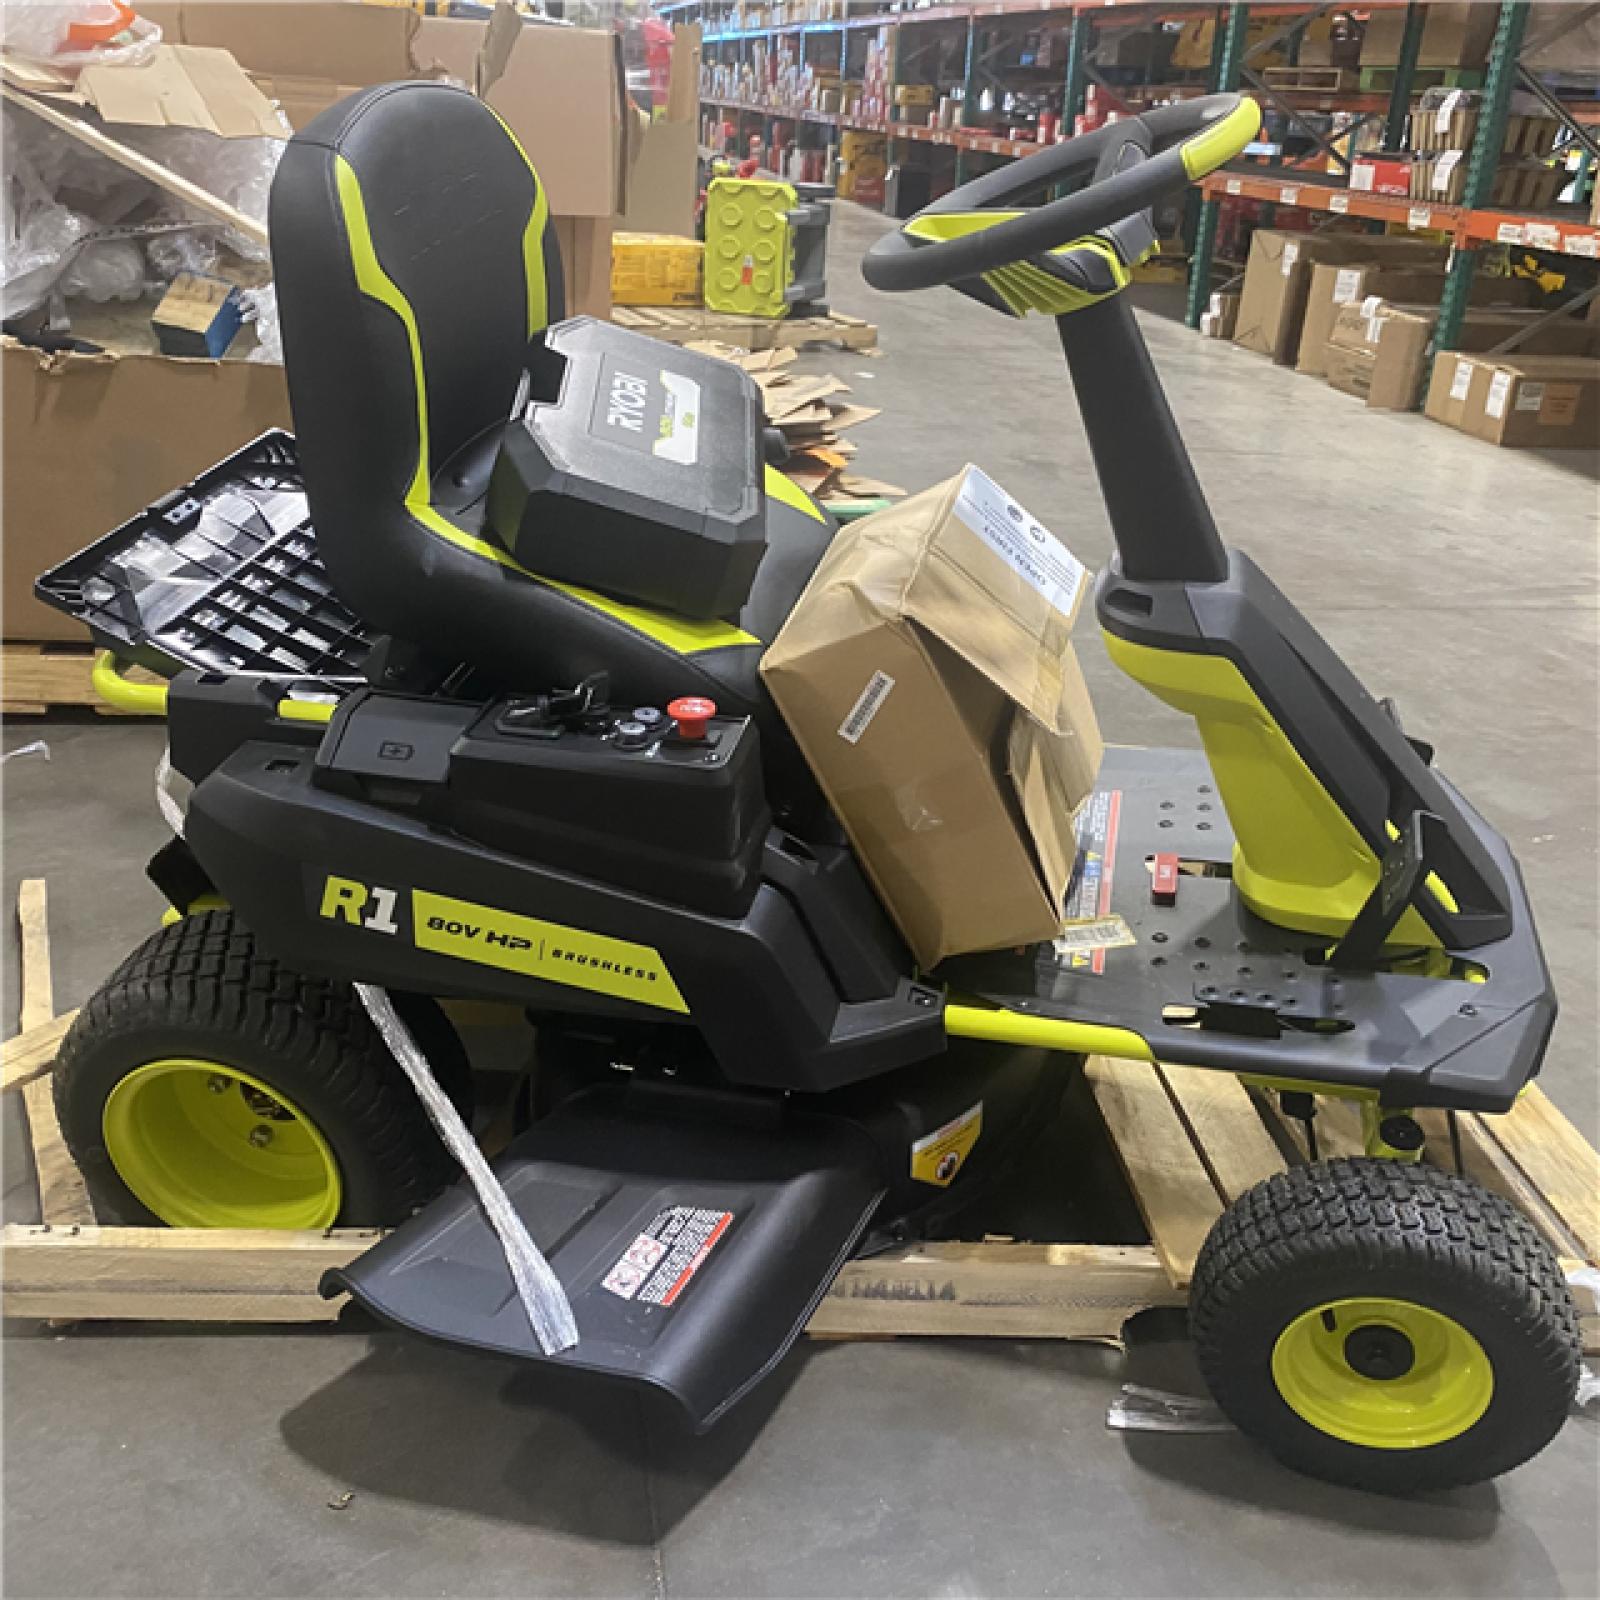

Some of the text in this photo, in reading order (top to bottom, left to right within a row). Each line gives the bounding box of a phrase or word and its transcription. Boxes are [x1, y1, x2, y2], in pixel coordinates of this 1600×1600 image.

[607, 371, 647, 432] RYOBI
[320, 875, 398, 935] R1
[427, 917, 657, 981] 80V HP BRUSHLESS
